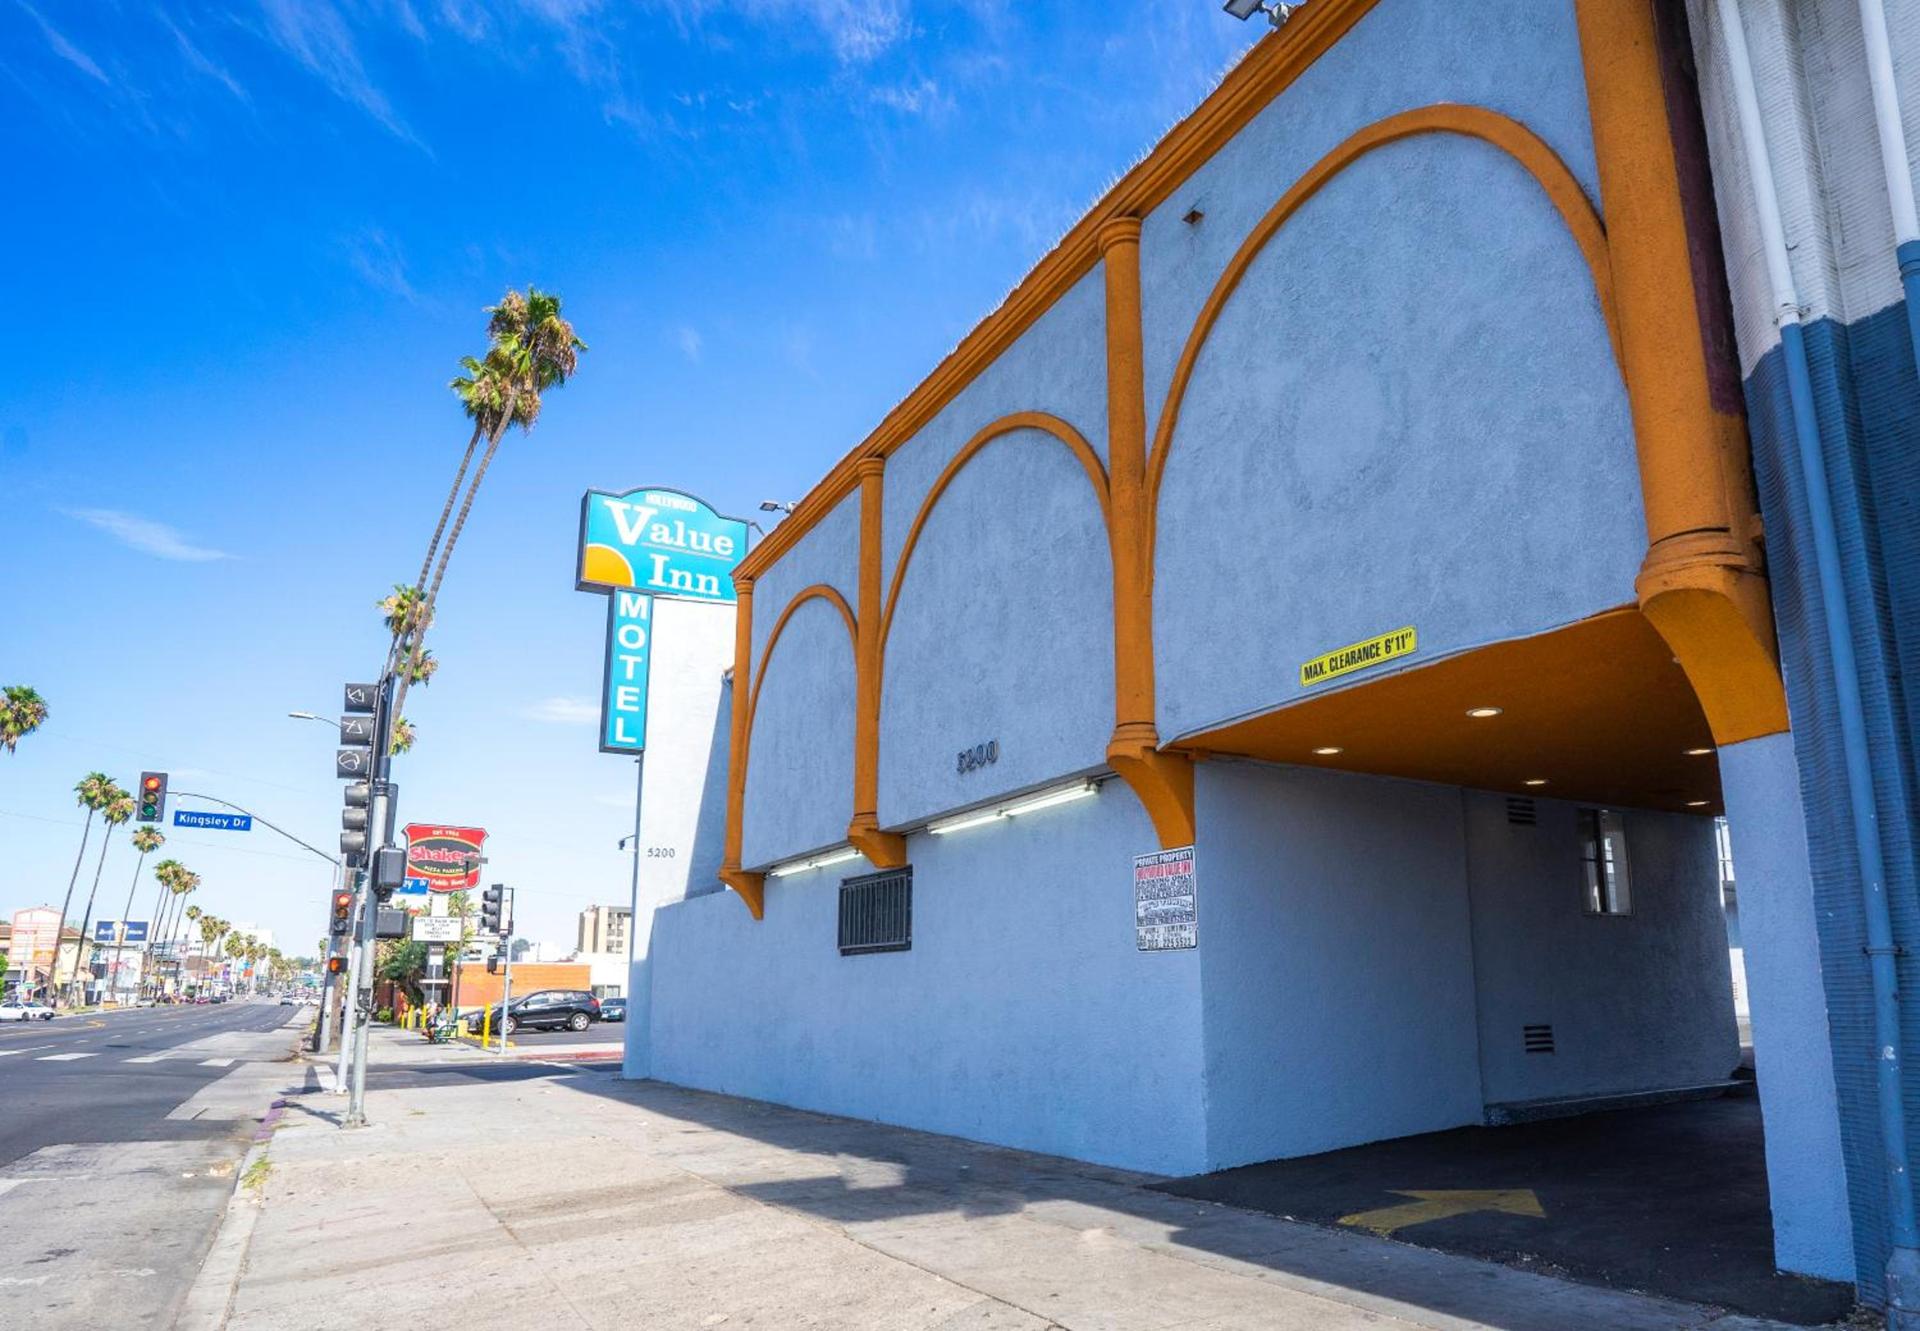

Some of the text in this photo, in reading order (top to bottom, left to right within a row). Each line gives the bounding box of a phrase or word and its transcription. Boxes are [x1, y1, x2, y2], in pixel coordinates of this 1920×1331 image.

[603, 499, 735, 556] Value
[647, 553, 721, 596] Inn
[615, 594, 647, 743] MOTEL
[1304, 656, 1327, 680] MAX.
[1329, 641, 1381, 672] CLEARANCE
[179, 813, 247, 828] Kingsley Dr
[647, 847, 676, 858] 5200
[1160, 850, 1192, 864] PROPERTY
[1172, 873, 1192, 882] ONLY
